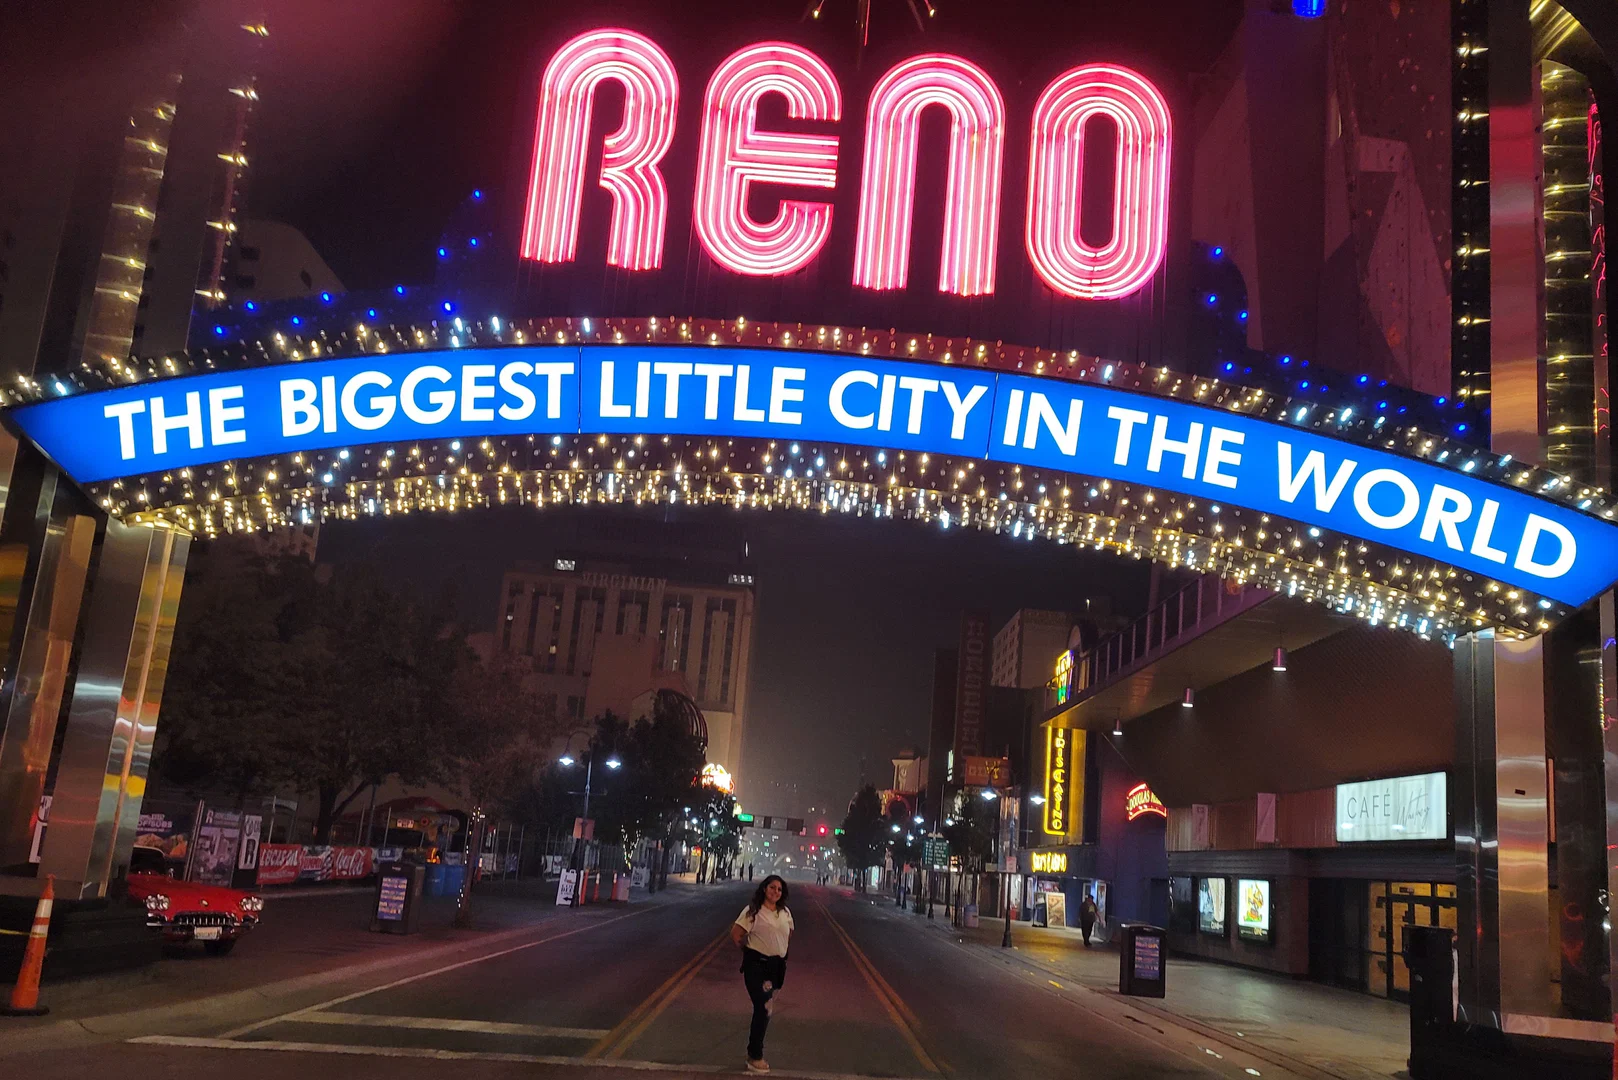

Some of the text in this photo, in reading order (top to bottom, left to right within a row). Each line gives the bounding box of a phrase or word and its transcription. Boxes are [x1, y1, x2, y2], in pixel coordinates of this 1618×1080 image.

[519, 27, 1172, 300] RENO
[104, 360, 1578, 580] THE BIGGEST LITTLE CITY IN THE WORLD
[583, 572, 668, 592] VIRGINIAN
[1347, 788, 1391, 819] CAFÉ
